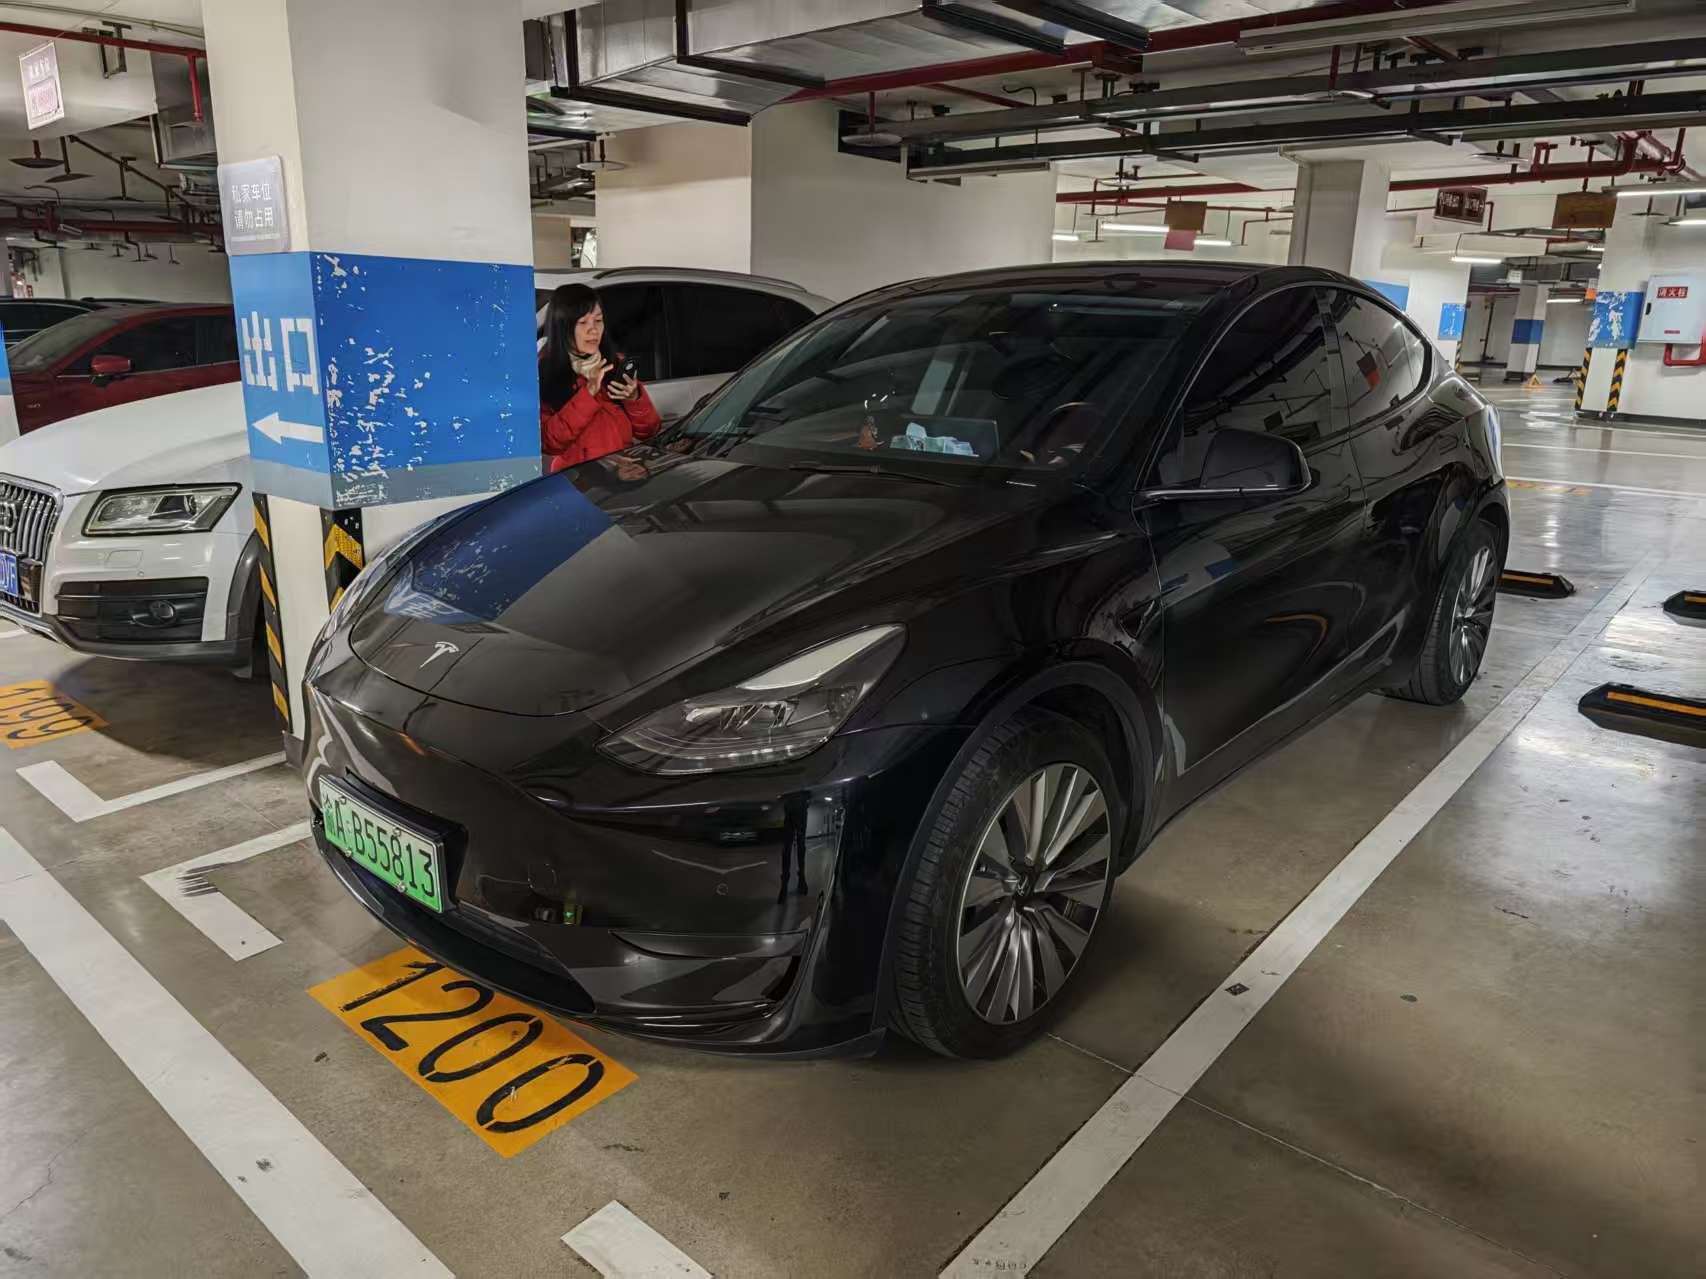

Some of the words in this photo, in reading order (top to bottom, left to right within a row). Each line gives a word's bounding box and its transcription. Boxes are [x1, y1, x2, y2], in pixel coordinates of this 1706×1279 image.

[232, 183, 272, 203] 私家车位
[233, 207, 273, 232] 请勿占用
[241, 311, 319, 395] 出口
[339, 961, 605, 1134] 1200
